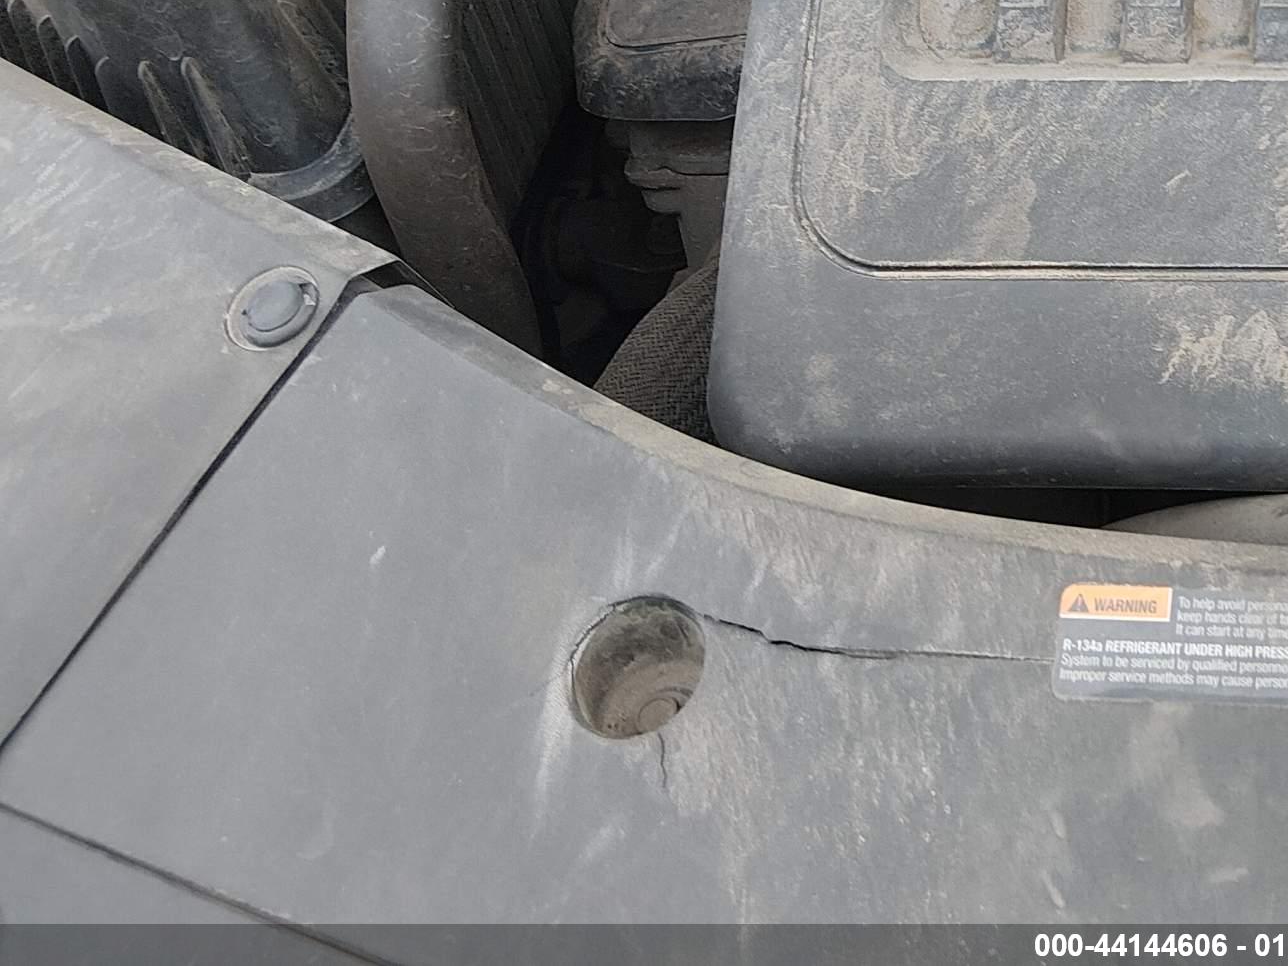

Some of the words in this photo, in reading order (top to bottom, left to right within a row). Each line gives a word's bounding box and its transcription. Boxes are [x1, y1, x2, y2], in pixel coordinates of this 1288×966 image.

[1094, 597, 1157, 614] WARNING
[1178, 596, 1191, 609] To
[1193, 597, 1214, 612] help
[1217, 600, 1245, 613] avoid
[1176, 609, 1201, 623] keep
[1204, 612, 1236, 624] hands
[1238, 613, 1264, 625] clear
[1266, 614, 1278, 625] of
[1176, 624, 1183, 635] It
[1185, 626, 1204, 636] can
[1207, 626, 1232, 637] start
[1233, 627, 1244, 638] at
[1246, 629, 1264, 640] any
[1063, 638, 1103, 652] R-134a
[1105, 640, 1182, 655] REFRIGERANT
[1184, 642, 1222, 657] UNDER
[1225, 644, 1252, 658] HIGH
[1061, 653, 1100, 668] System
[1102, 655, 1113, 667] to
[1115, 655, 1129, 668] be
[1131, 656, 1175, 669] serviced
[1176, 658, 1189, 671] by
[1191, 658, 1237, 672] qualified
[1060, 667, 1106, 683] Improper
[1108, 670, 1147, 683] service
[1149, 671, 1194, 684] methods
[1196, 673, 1219, 688] may
[1221, 675, 1252, 687] cause
